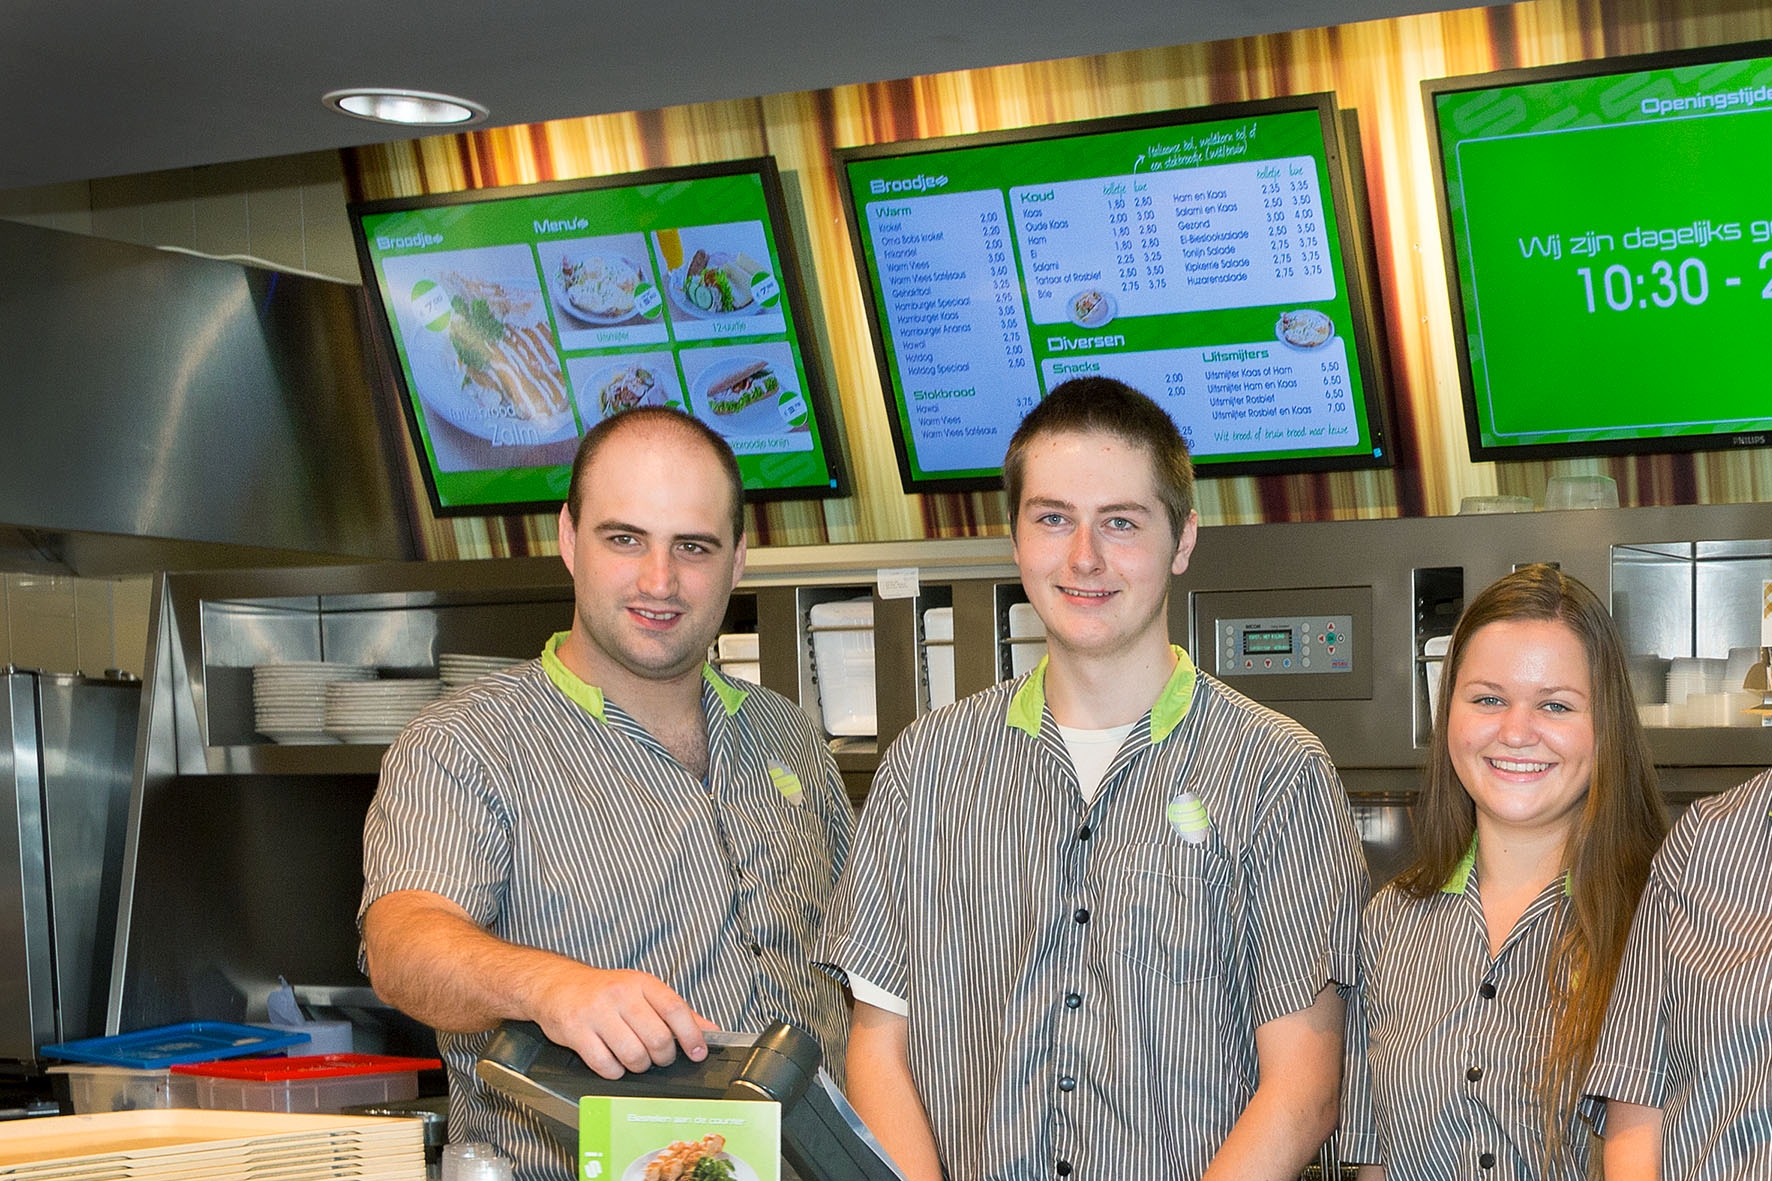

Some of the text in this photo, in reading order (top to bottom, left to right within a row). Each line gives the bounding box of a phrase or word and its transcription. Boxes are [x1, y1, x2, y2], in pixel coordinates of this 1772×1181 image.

[1020, 190, 1055, 203] Koud
[1173, 192, 1193, 203] Ham
[1194, 192, 1205, 201] en
[1207, 190, 1227, 200] Kaas
[876, 206, 912, 218] Warm
[1178, 209, 1313, 231] Gezond 3,00 4,00
[1519, 234, 1562, 260] Wij
[1570, 233, 1614, 258] zijn
[1622, 219, 1742, 251] dagelijks
[1577, 257, 1709, 313] 10:30
[1047, 334, 1125, 352] Diversen
[1202, 349, 1269, 363] Uitsmijters
[1053, 361, 1100, 374] Snacks
[1205, 369, 1239, 381] Uitsmijter
[1241, 367, 1261, 378] Kaas
[1263, 366, 1271, 376] of
[1273, 365, 1293, 375] Ham
[914, 386, 976, 400] Stokbrood
[1733, 436, 1765, 444] PHILIPS
